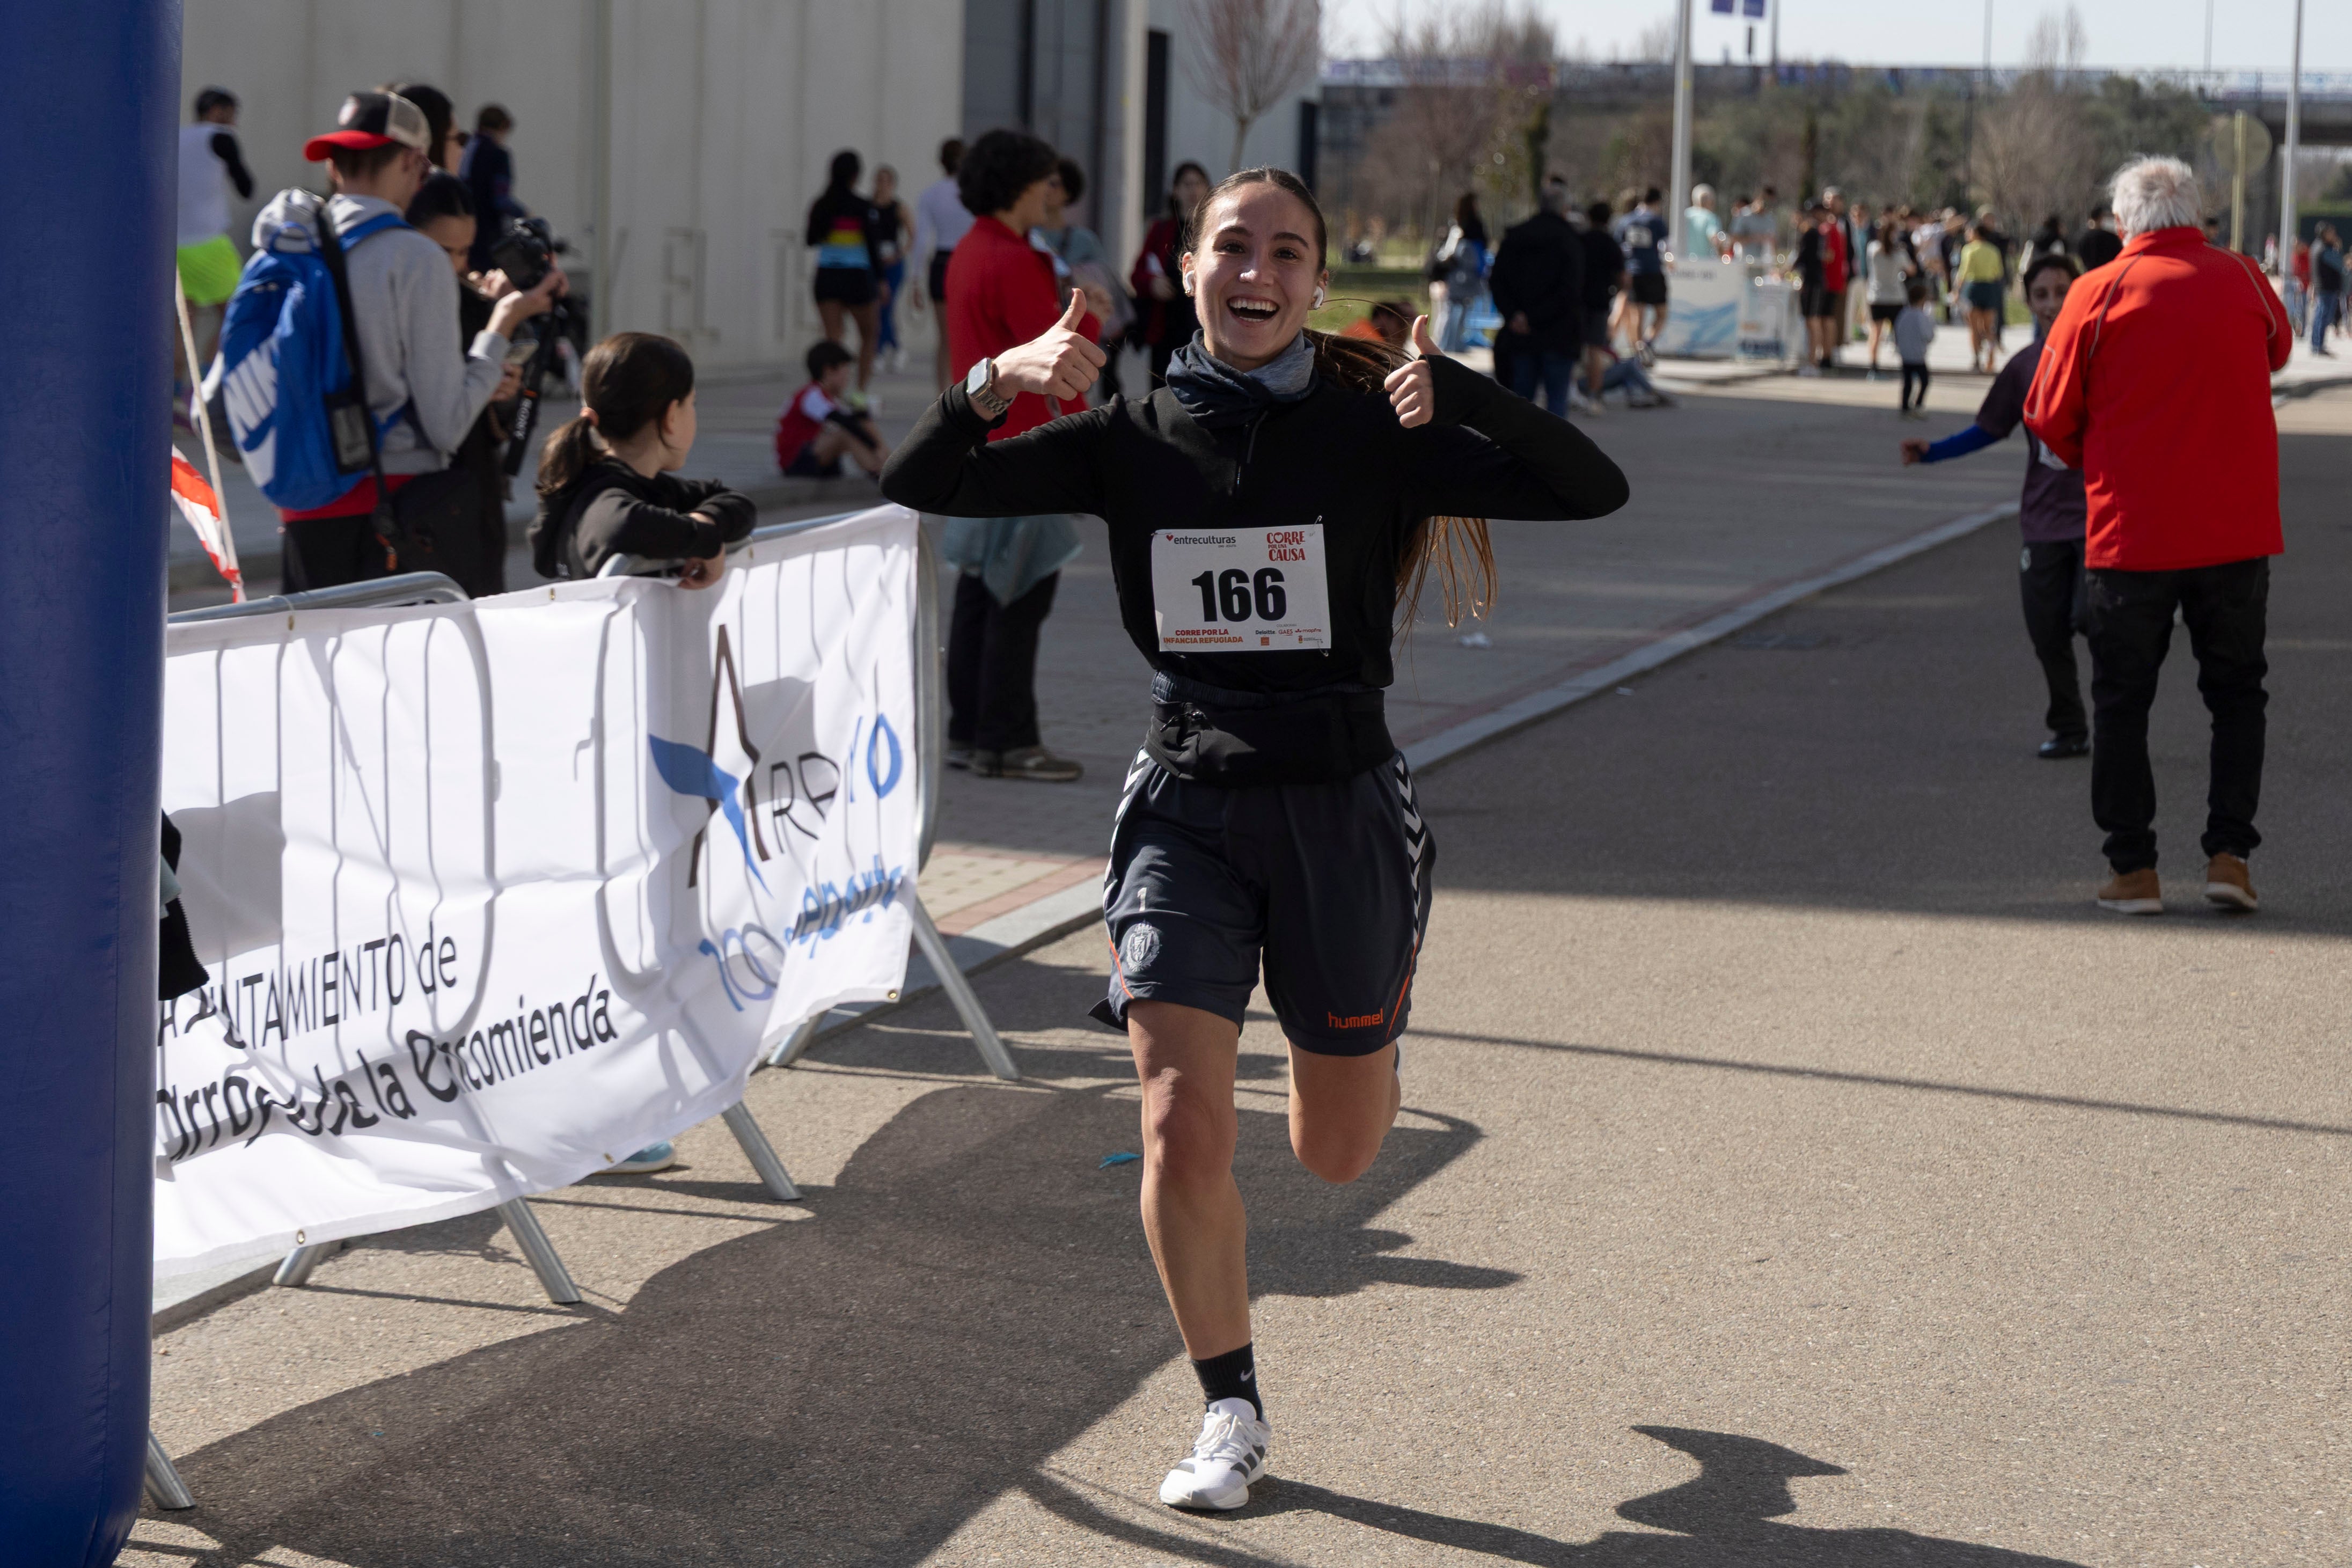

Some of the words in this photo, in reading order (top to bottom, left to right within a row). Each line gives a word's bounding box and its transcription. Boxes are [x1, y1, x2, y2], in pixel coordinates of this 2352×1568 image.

[1174, 536, 1236, 544] entreculturas
[1267, 531, 1306, 545] CORRE
[1269, 548, 1306, 561] CAUSA
[1192, 567, 1287, 622] 166
[1138, 887, 1147, 911] 1
[418, 917, 457, 994] de
[1328, 1008, 1383, 1029] hummel
[358, 1048, 417, 1120] la
